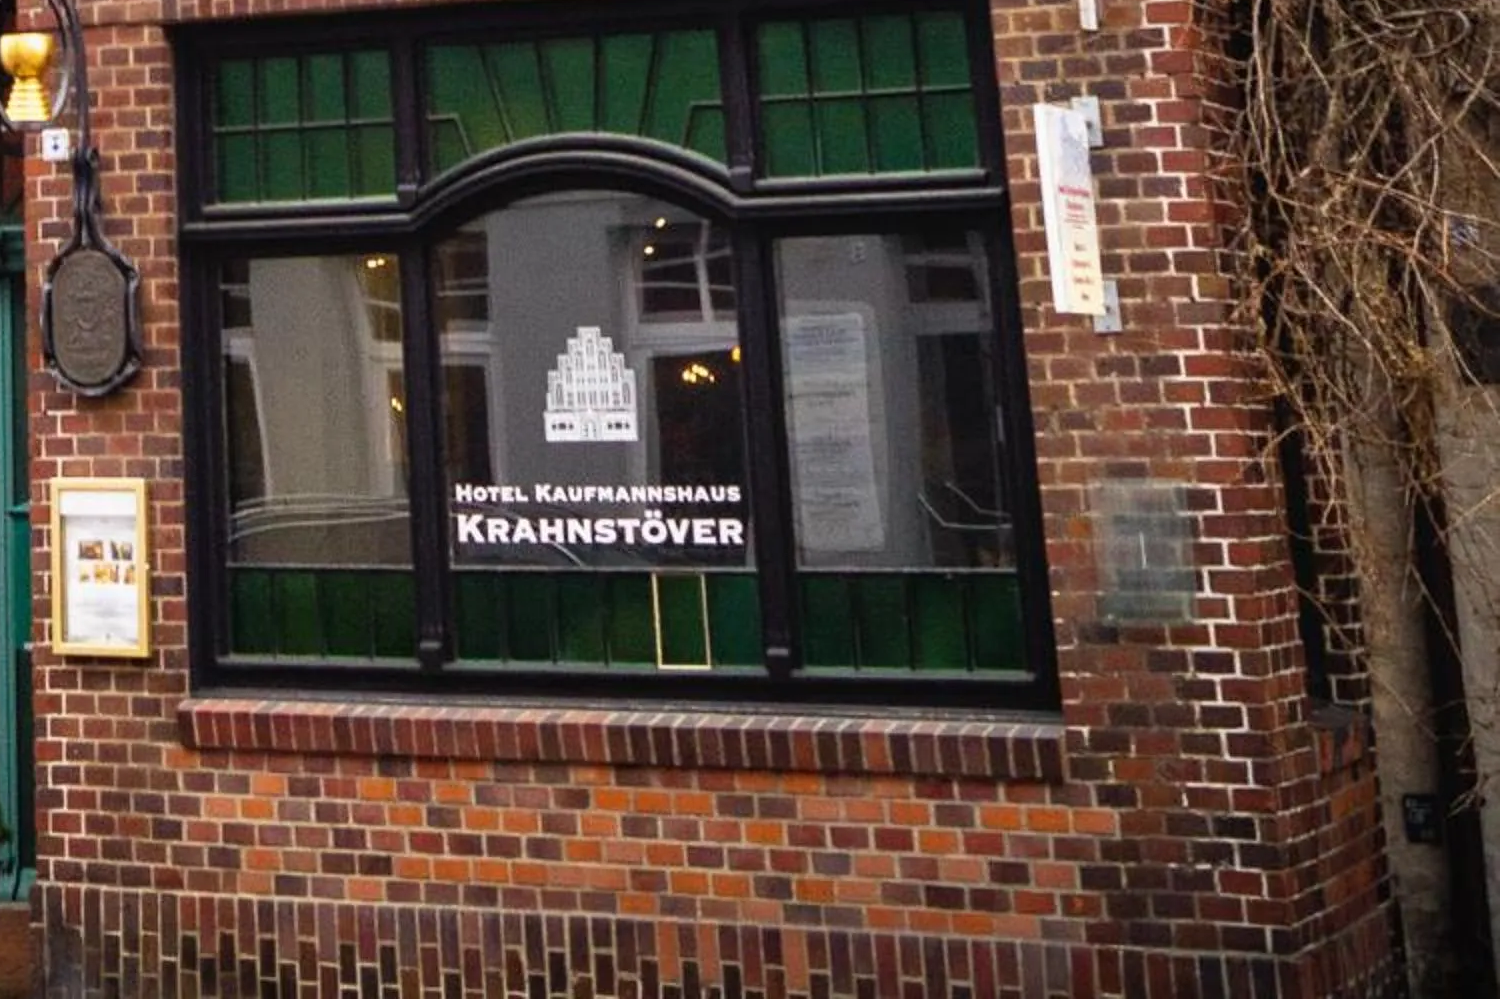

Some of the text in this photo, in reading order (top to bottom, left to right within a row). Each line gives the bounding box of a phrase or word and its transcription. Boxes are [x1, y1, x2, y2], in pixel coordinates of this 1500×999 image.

[455, 483, 741, 502] HOTEL KAUFMANNSHAUS
[456, 510, 745, 544] KRAHNSTÖVER
